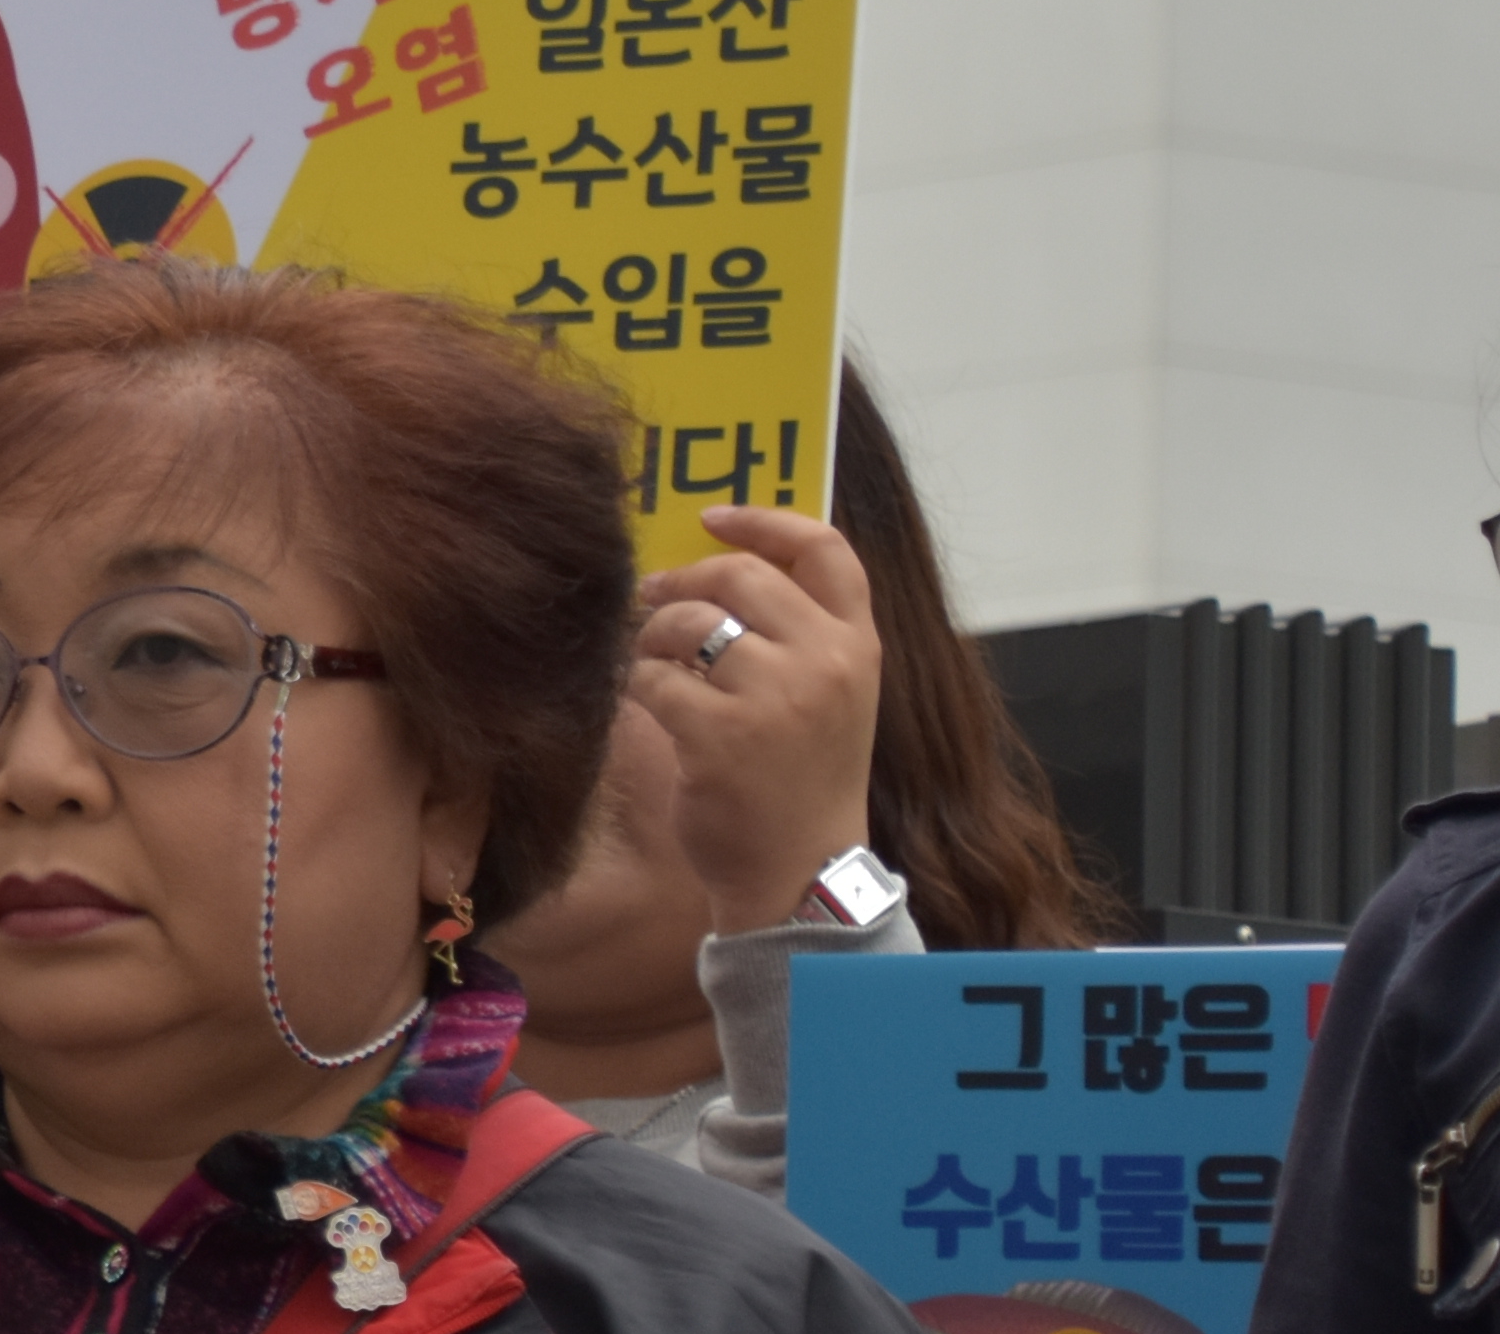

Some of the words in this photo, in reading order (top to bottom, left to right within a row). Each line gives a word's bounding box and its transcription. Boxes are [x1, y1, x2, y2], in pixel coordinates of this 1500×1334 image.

[302, 2, 489, 141] 오염
[449, 103, 822, 220] 농수산물
[506, 245, 783, 352] 수입을
[955, 984, 1049, 1091] 그
[1082, 982, 1274, 1095] 많은
[902, 1153, 1286, 1263] 수산물은
